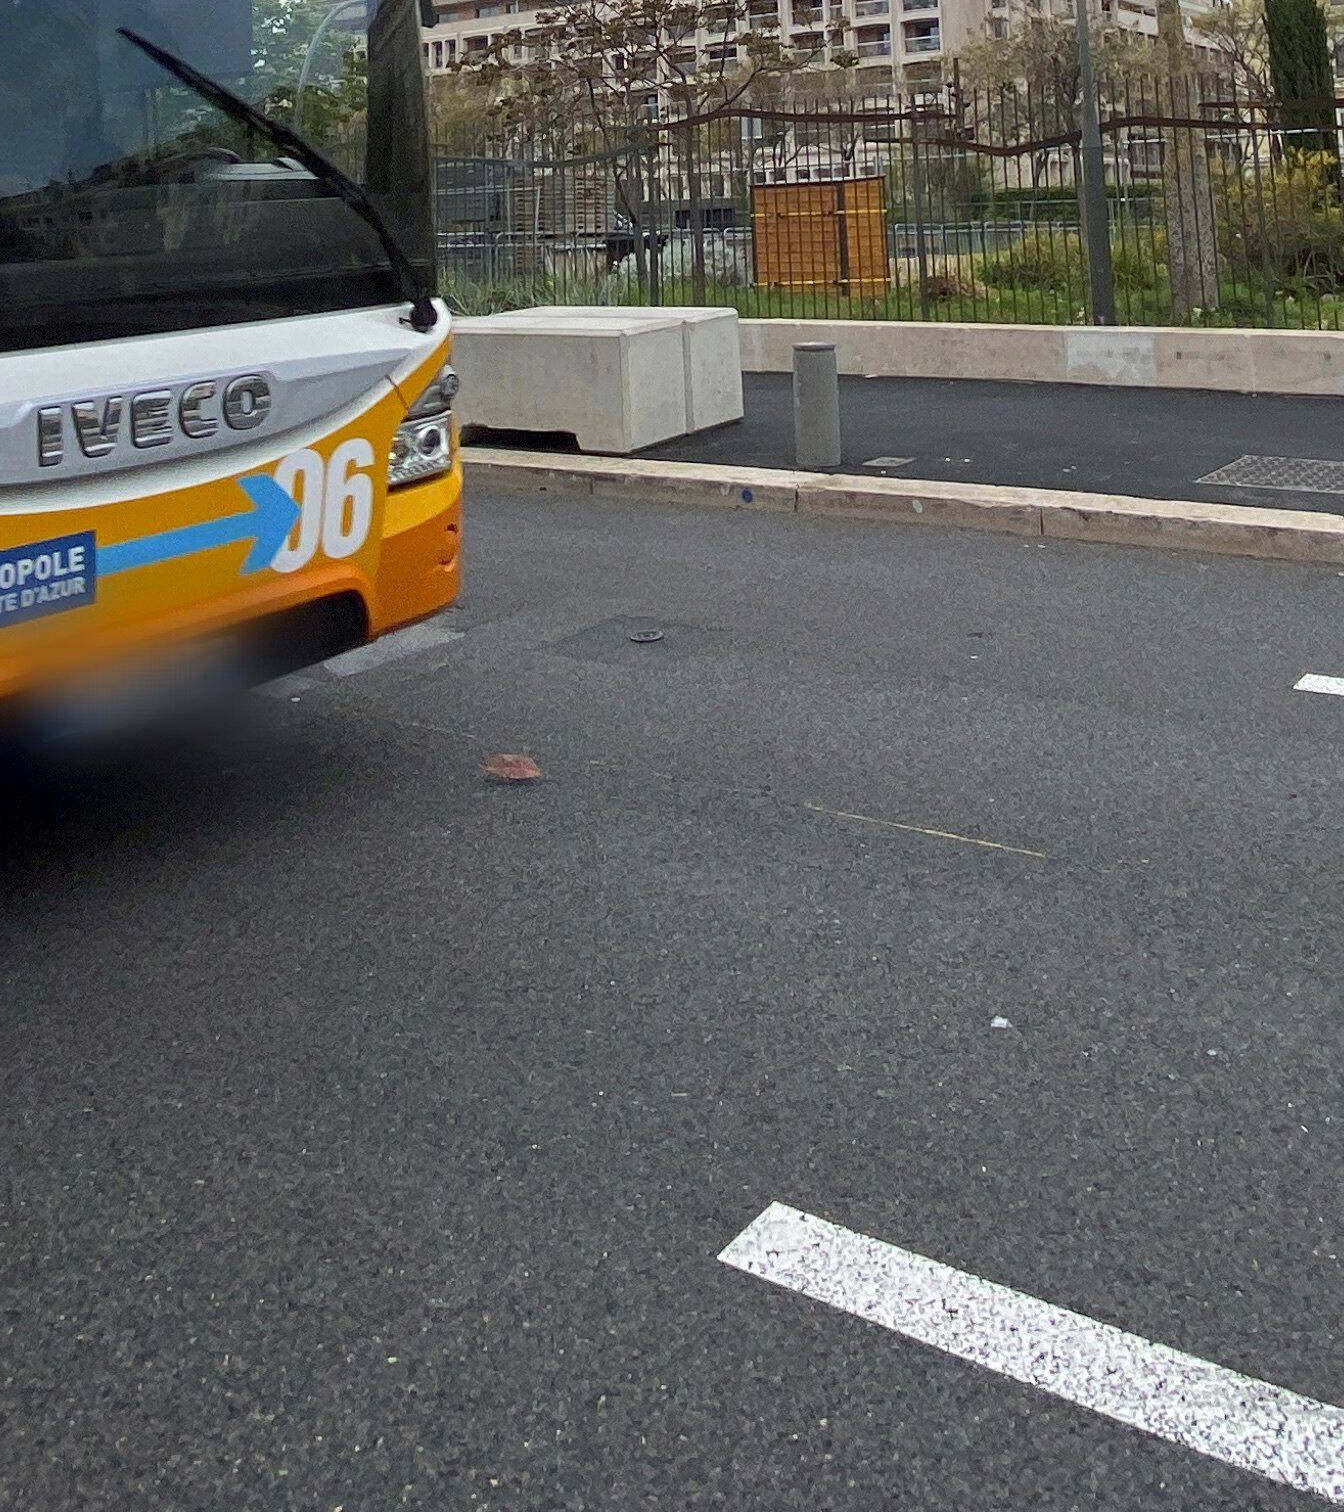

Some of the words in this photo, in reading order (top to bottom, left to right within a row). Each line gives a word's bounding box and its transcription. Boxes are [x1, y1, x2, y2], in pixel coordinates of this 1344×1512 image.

[37, 374, 272, 467] IVECO
[270, 438, 375, 574] 06
[20, 576, 87, 608] D'AZUR
